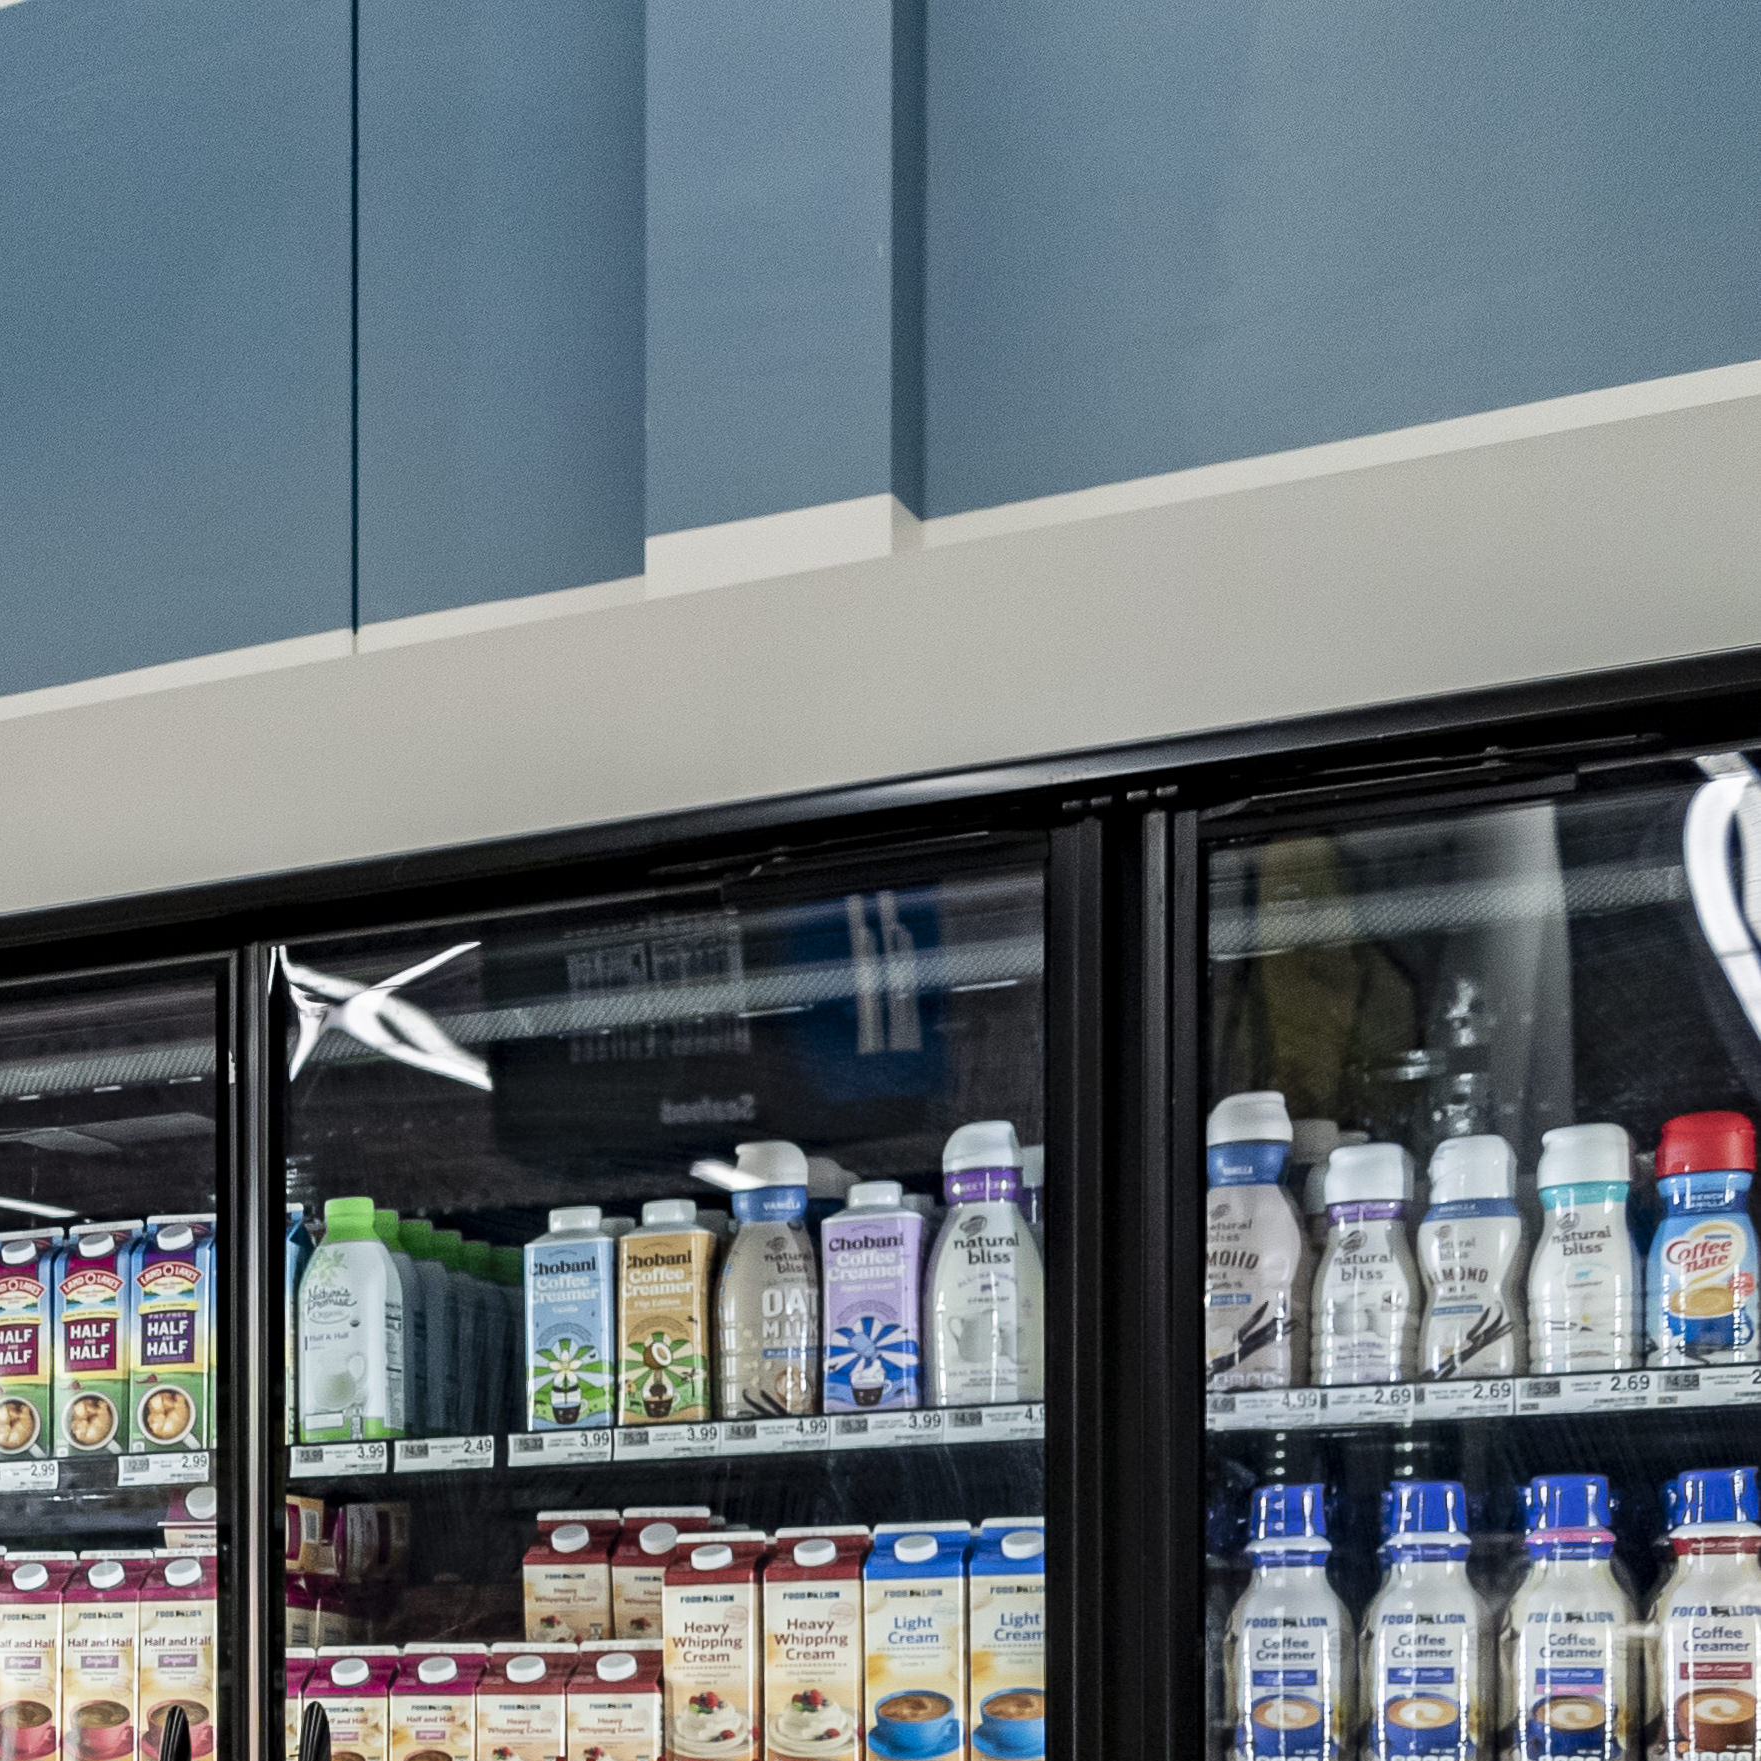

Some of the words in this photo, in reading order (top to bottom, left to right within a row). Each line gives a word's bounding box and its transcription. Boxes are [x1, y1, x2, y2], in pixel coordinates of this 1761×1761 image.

[827, 1234, 905, 1252] Chobani
[953, 1233, 1020, 1250] natural
[1551, 1225, 1612, 1244] natural
[1562, 1240, 1604, 1256] bliss
[834, 1251, 896, 1267] Coffee
[967, 1248, 1012, 1266] bliss
[825, 1264, 906, 1281] Creamer
[147, 1319, 189, 1336] HALF
[147, 1339, 188, 1356] HALF
[1610, 1375, 1650, 1393] 2.69
[579, 1429, 610, 1446] 3.99
[31, 1463, 55, 1478] 2.99
[682, 1619, 730, 1640] Heavy
[894, 1614, 934, 1633] Light
[887, 1629, 940, 1647] Cream
[1691, 1626, 1744, 1640] Coffee
[672, 1632, 744, 1652] Whipping
[1683, 1639, 1750, 1654] Creamer
[682, 1648, 732, 1666] Cream
